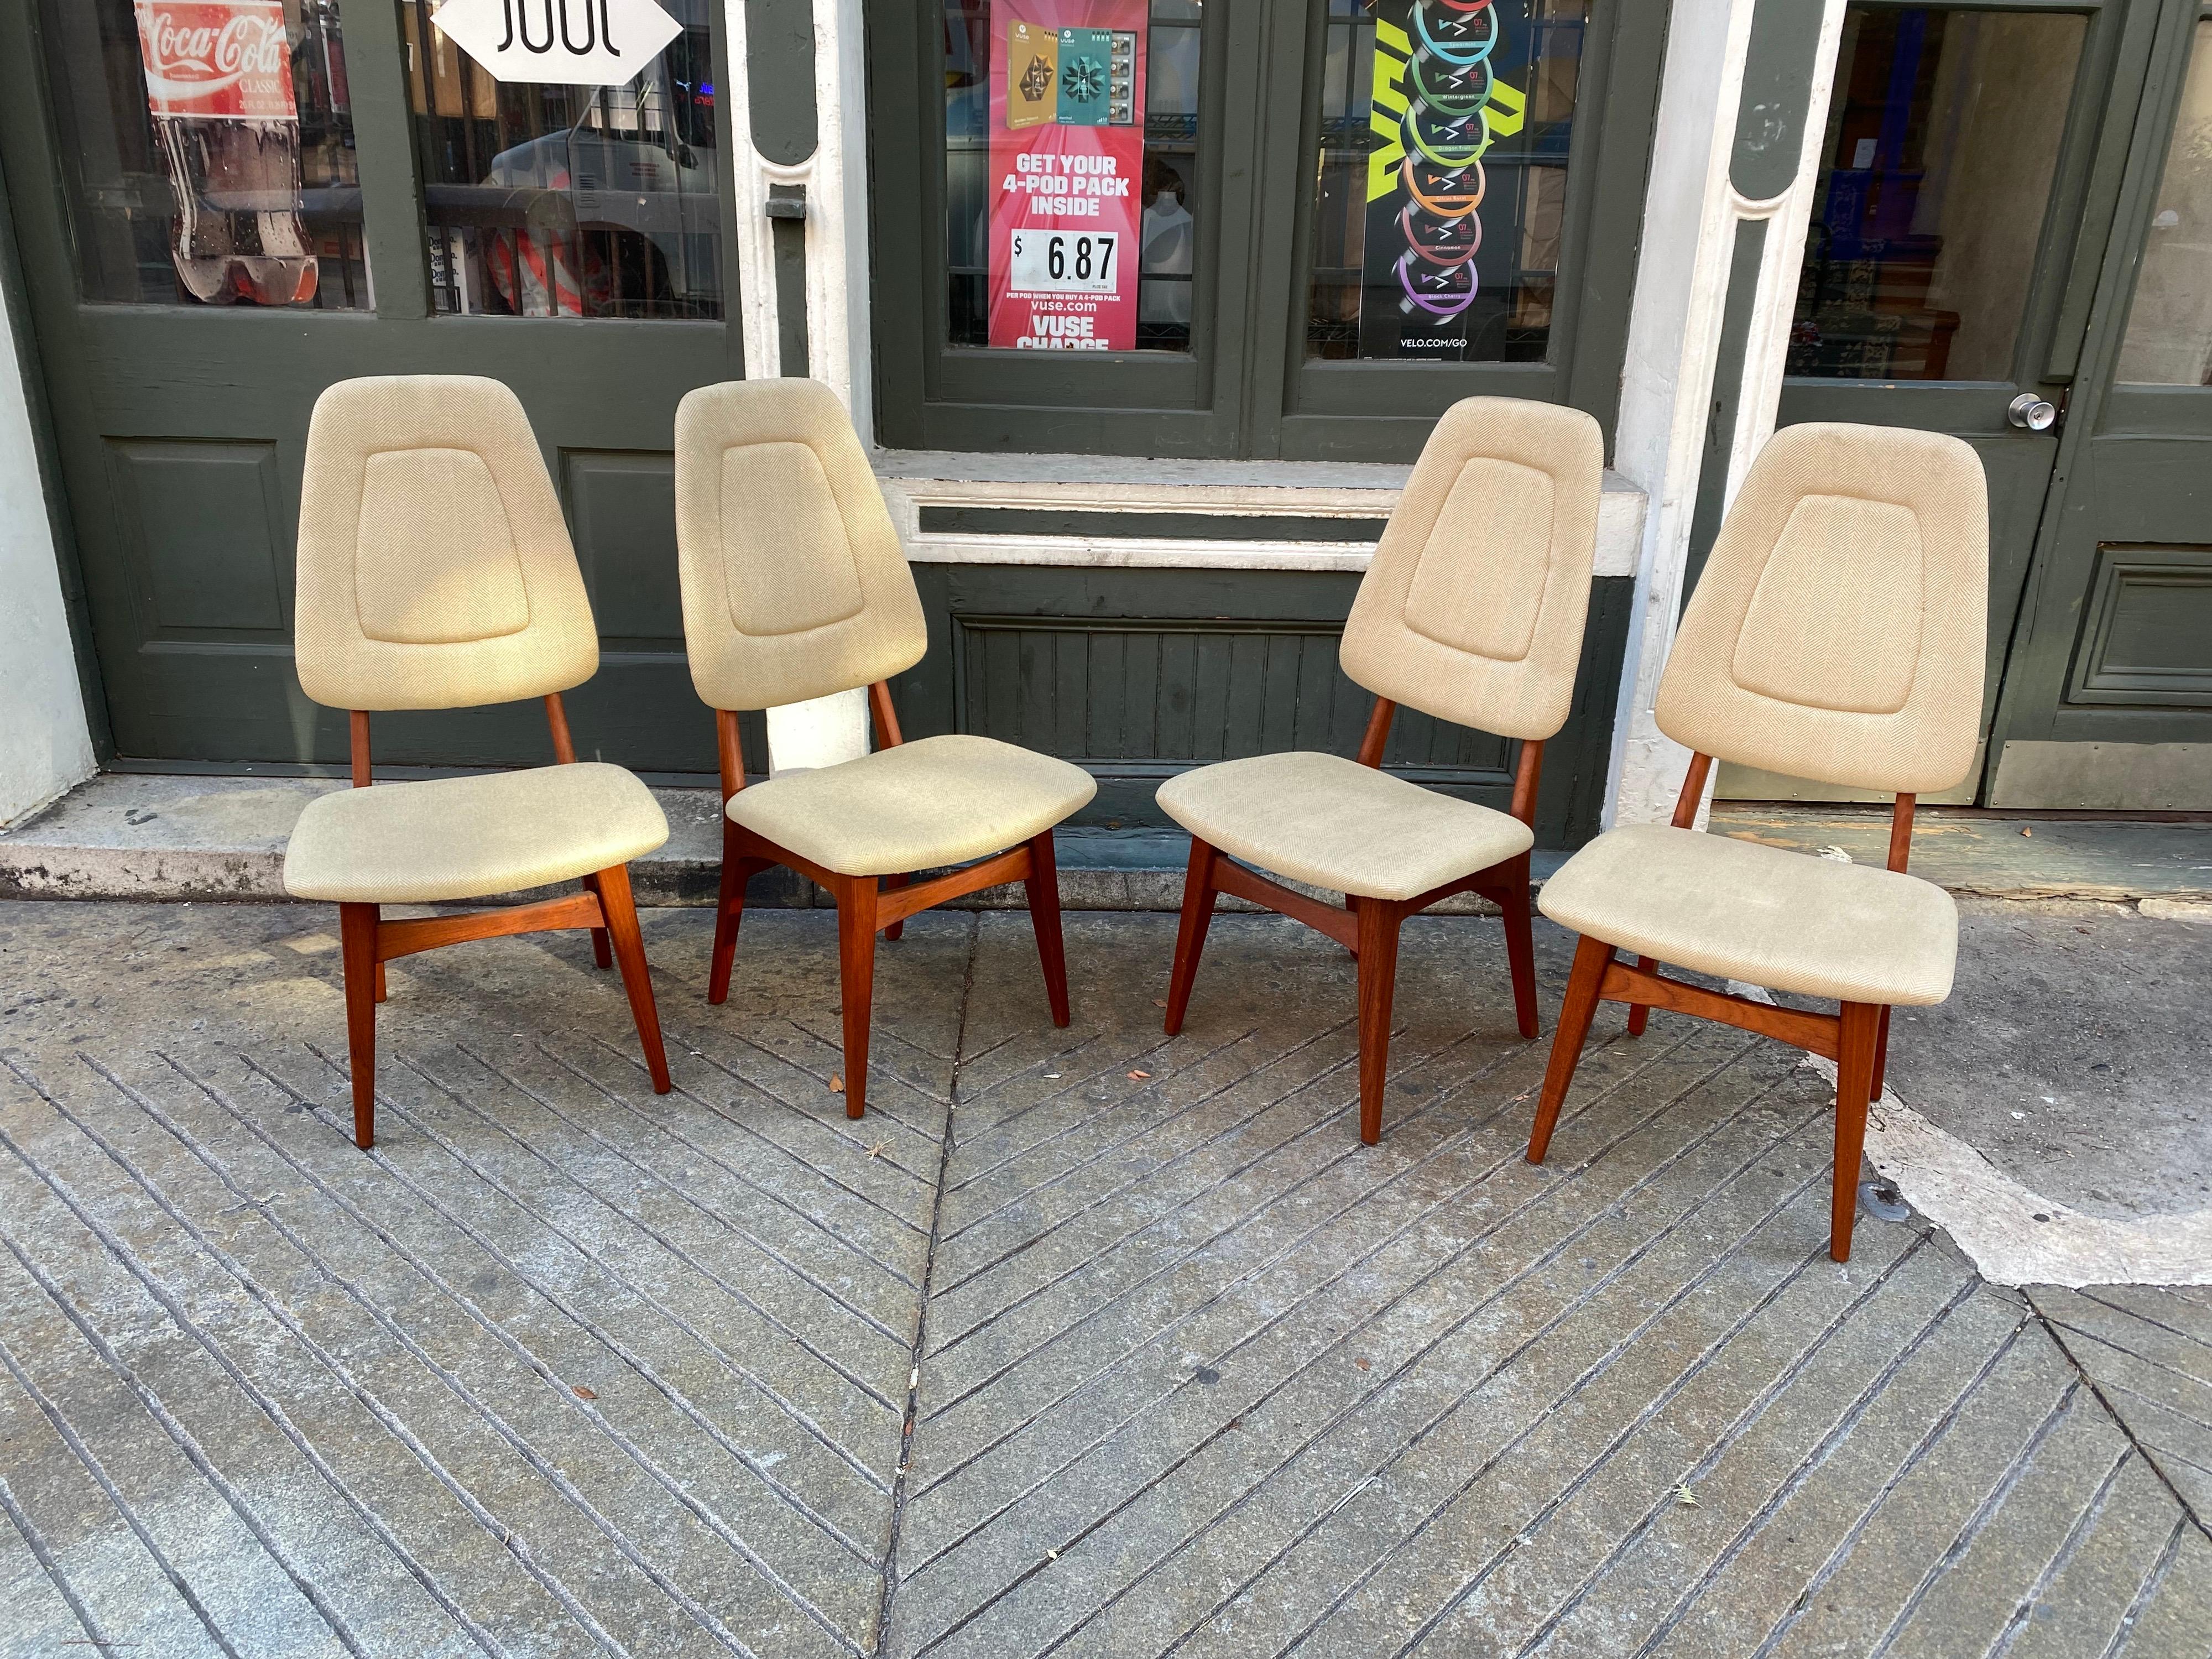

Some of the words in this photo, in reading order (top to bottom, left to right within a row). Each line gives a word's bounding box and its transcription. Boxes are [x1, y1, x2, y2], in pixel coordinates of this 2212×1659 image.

[148, 13, 285, 73] Coca-Cola
[239, 79, 281, 93] CLASSIC
[1016, 153, 1055, 173] GET
[1060, 155, 1117, 175] YOUR
[1003, 174, 1068, 194] 4-POD
[1073, 176, 1129, 196] PACK
[1032, 196, 1099, 216] INSIDE
[1014, 236, 1022, 257] $
[1048, 236, 1114, 280] 6.87
[1031, 301, 1097, 312] vuse.com
[1033, 315, 1094, 337] VUSE
[1400, 339, 1467, 347] VELO.COM/GO
